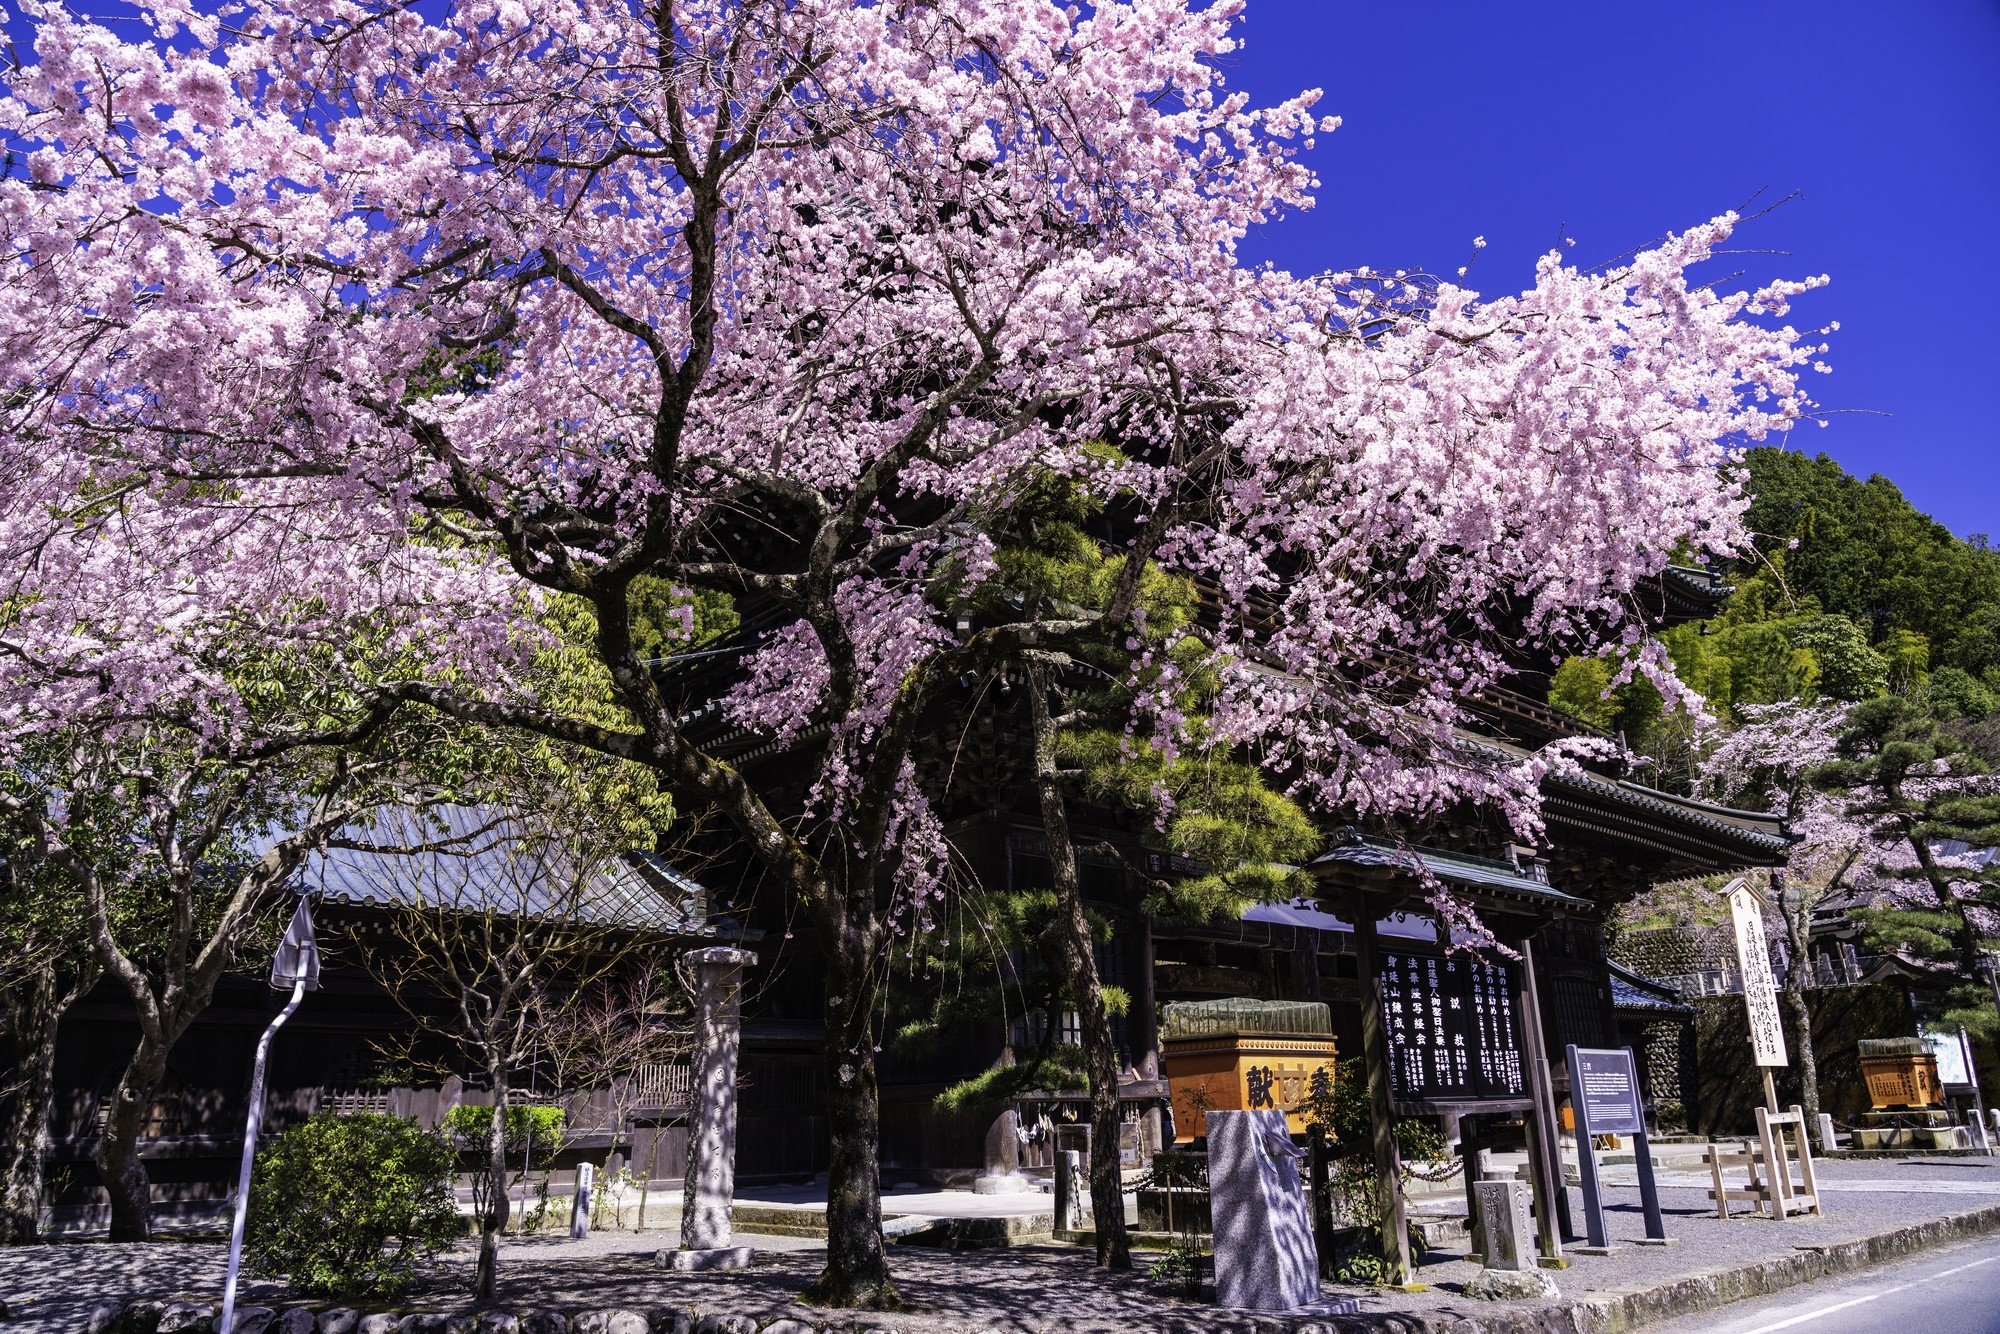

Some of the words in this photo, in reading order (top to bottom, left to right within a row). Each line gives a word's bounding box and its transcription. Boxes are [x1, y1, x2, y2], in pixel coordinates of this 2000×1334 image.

[1407, 957, 1427, 1045] 法華経写経会
[1427, 959, 1446, 1046] 日蓮聖人御聖日法要
[1246, 1065, 1274, 1110] 献
